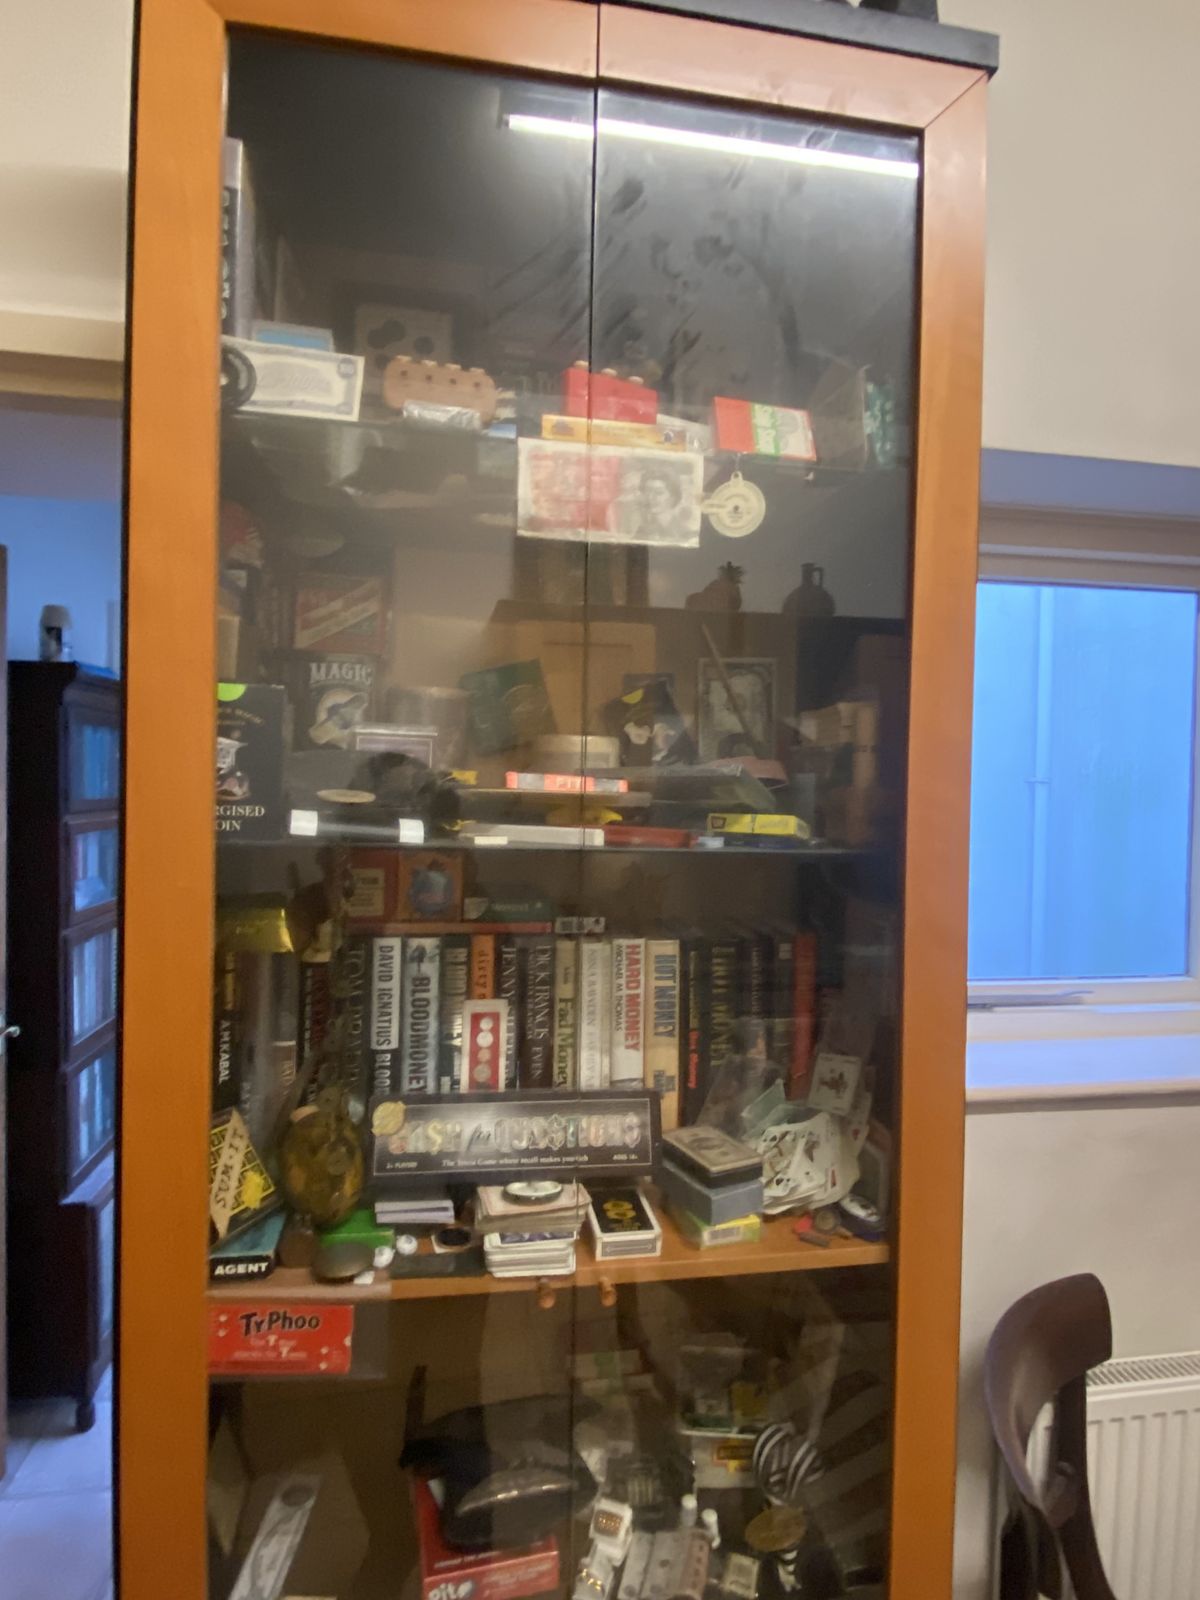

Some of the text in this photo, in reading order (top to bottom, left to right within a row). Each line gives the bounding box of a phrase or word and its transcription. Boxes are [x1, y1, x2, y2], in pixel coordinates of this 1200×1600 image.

[308, 661, 373, 684] MAGIC
[377, 945, 395, 982] DAVID
[475, 949, 490, 989] dirty
[500, 944, 517, 999] JENNY
[615, 944, 624, 980] MICHAEL
[533, 944, 552, 1041] DICK FRANCIS
[614, 995, 623, 1032] THOMAS
[624, 943, 641, 1053] HARD MONEY
[654, 954, 677, 1039] HOT MONEY
[376, 987, 393, 1047] IGNATIUS
[408, 976, 431, 1094] BLOODMONEY
[531, 1046, 544, 1079] EVEN
[554, 1031, 576, 1089] Money
[214, 1261, 269, 1276] AGENT
